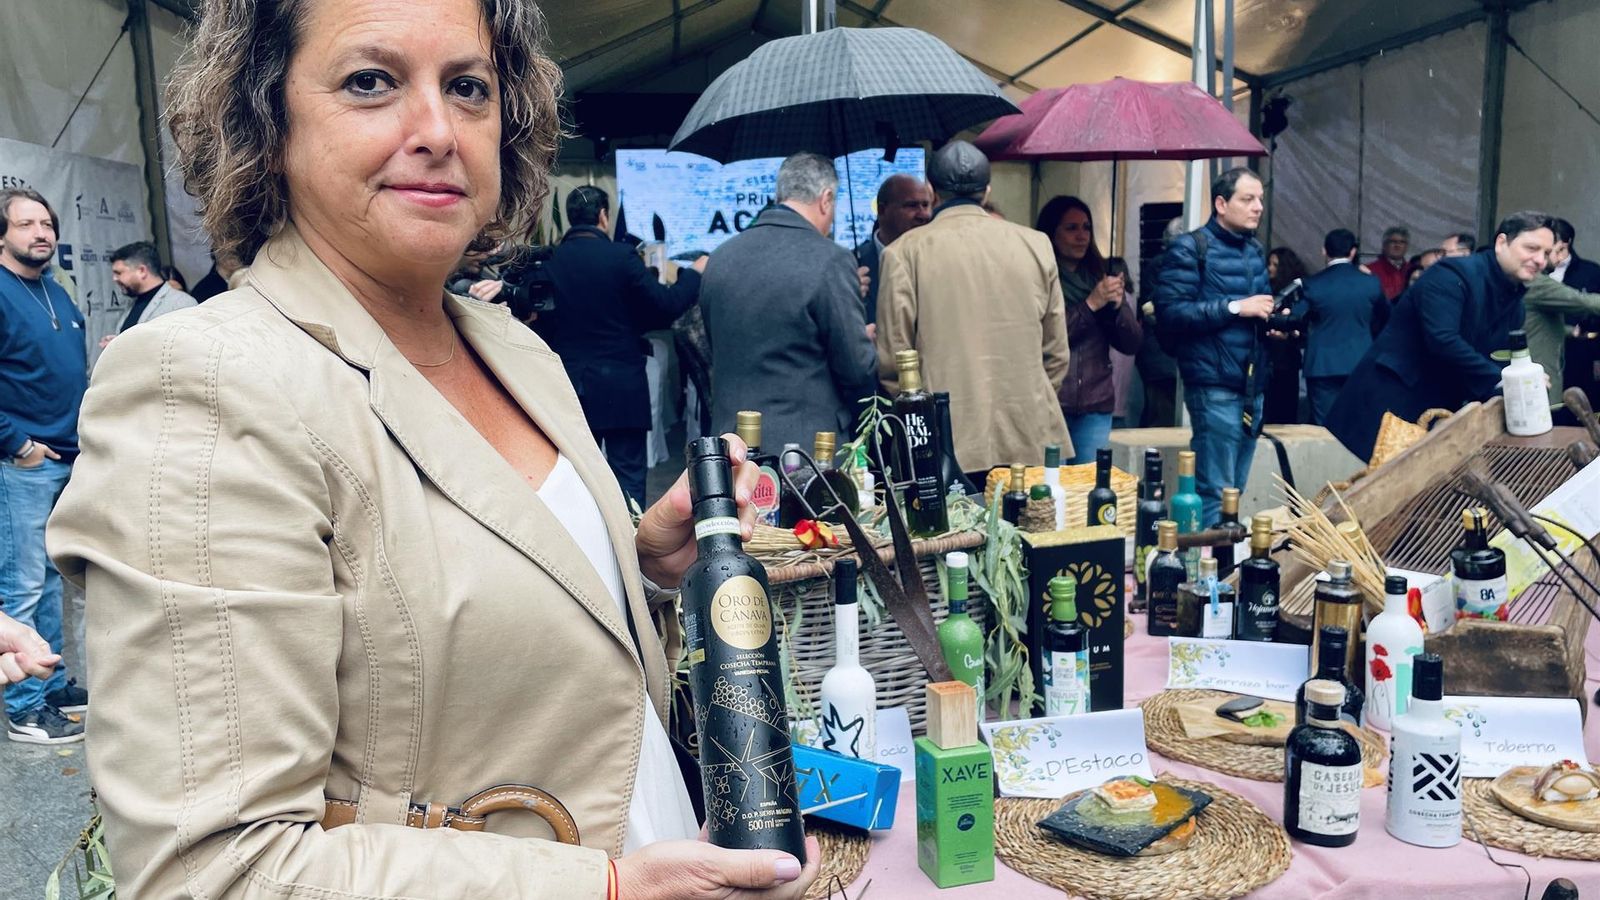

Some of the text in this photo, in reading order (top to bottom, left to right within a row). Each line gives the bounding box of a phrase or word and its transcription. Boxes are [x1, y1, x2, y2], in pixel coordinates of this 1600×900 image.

[718, 593, 766, 608] ORO DE
[720, 660, 751, 670] COSECHA
[1046, 752, 1144, 777] D'Estaco
[942, 762, 988, 784] XAVE
[748, 817, 775, 831] 500 ml
